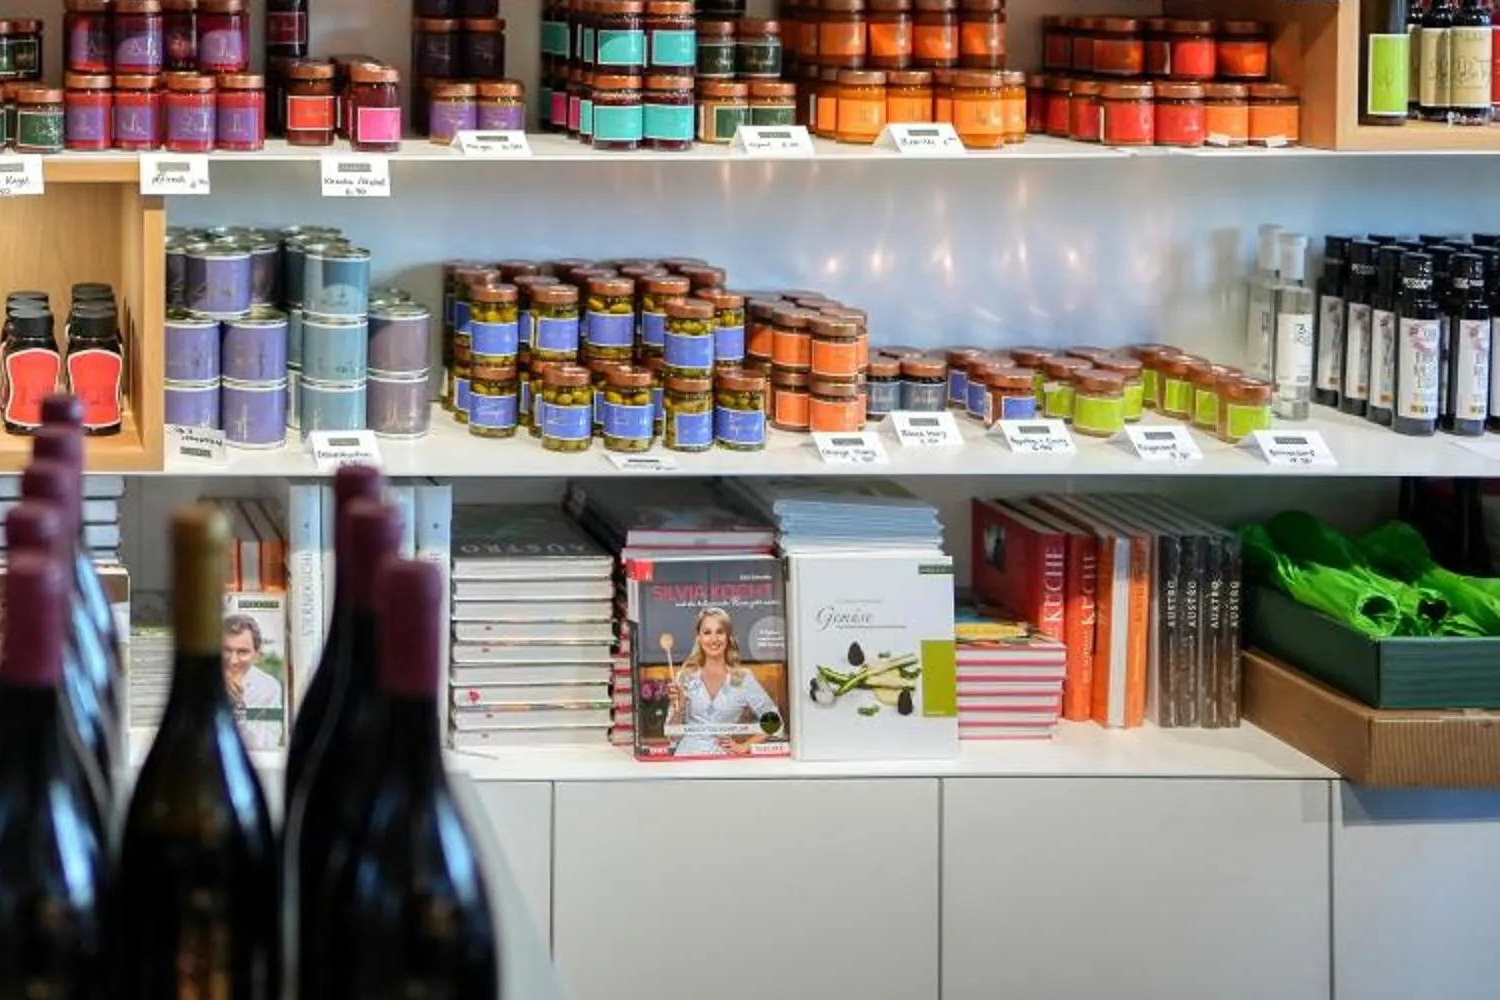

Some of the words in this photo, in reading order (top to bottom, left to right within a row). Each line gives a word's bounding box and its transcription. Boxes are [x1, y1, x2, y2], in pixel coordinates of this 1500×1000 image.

[652, 584, 705, 601] SILVIA
[711, 582, 773, 600] KOCHT
[1167, 580, 1176, 629] AUSTRO
[1187, 580, 1197, 629] AUSTRO
[1209, 580, 1220, 629] AUSTRO
[1230, 580, 1240, 628] AUSTRO
